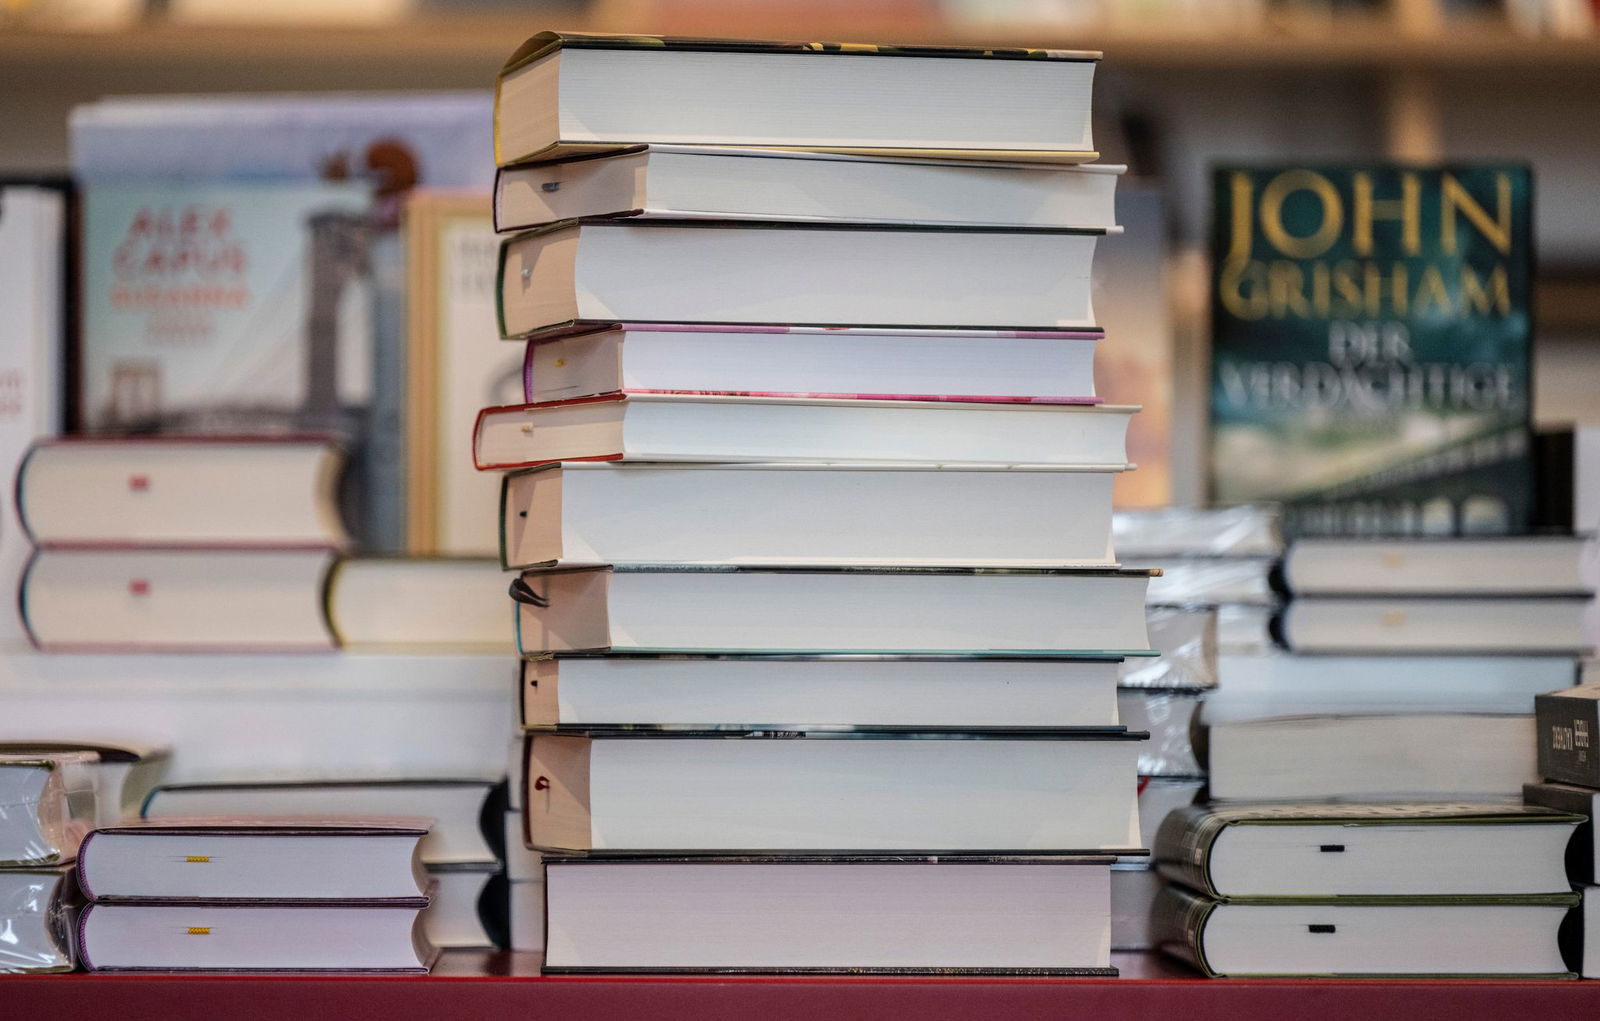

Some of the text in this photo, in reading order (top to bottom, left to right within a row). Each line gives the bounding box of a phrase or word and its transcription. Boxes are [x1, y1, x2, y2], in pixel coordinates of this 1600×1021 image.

[1230, 169, 1512, 258] JOHN
[1220, 260, 1512, 320] GRISHAM
[1329, 320, 1413, 365] DER
